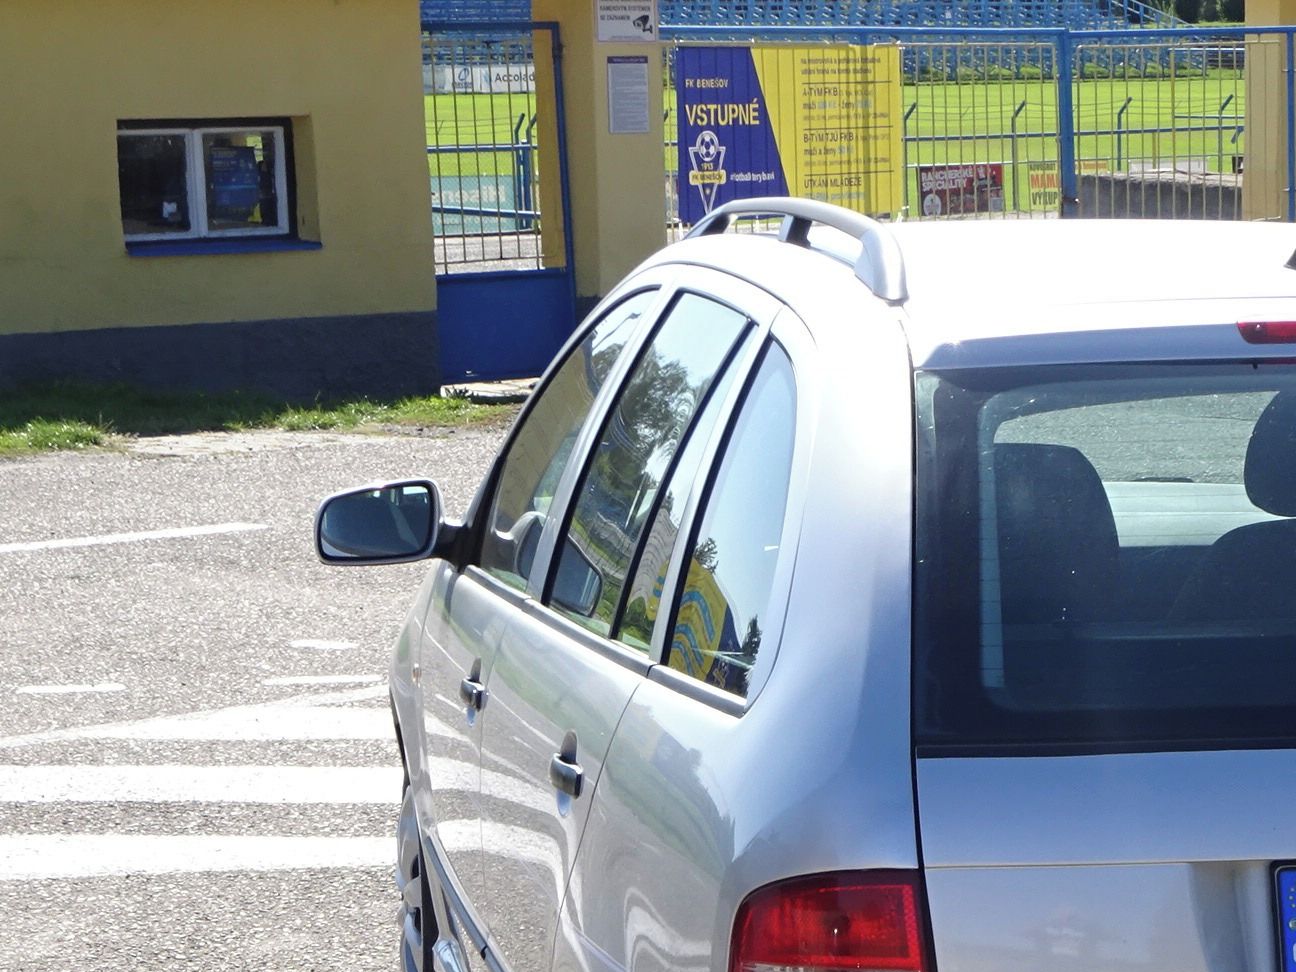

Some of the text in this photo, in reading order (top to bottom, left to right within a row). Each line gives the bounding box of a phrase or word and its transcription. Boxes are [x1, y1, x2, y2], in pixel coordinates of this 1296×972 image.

[685, 78, 729, 88] FK BENEŠOV
[685, 97, 760, 126] VSTUPNÉ
